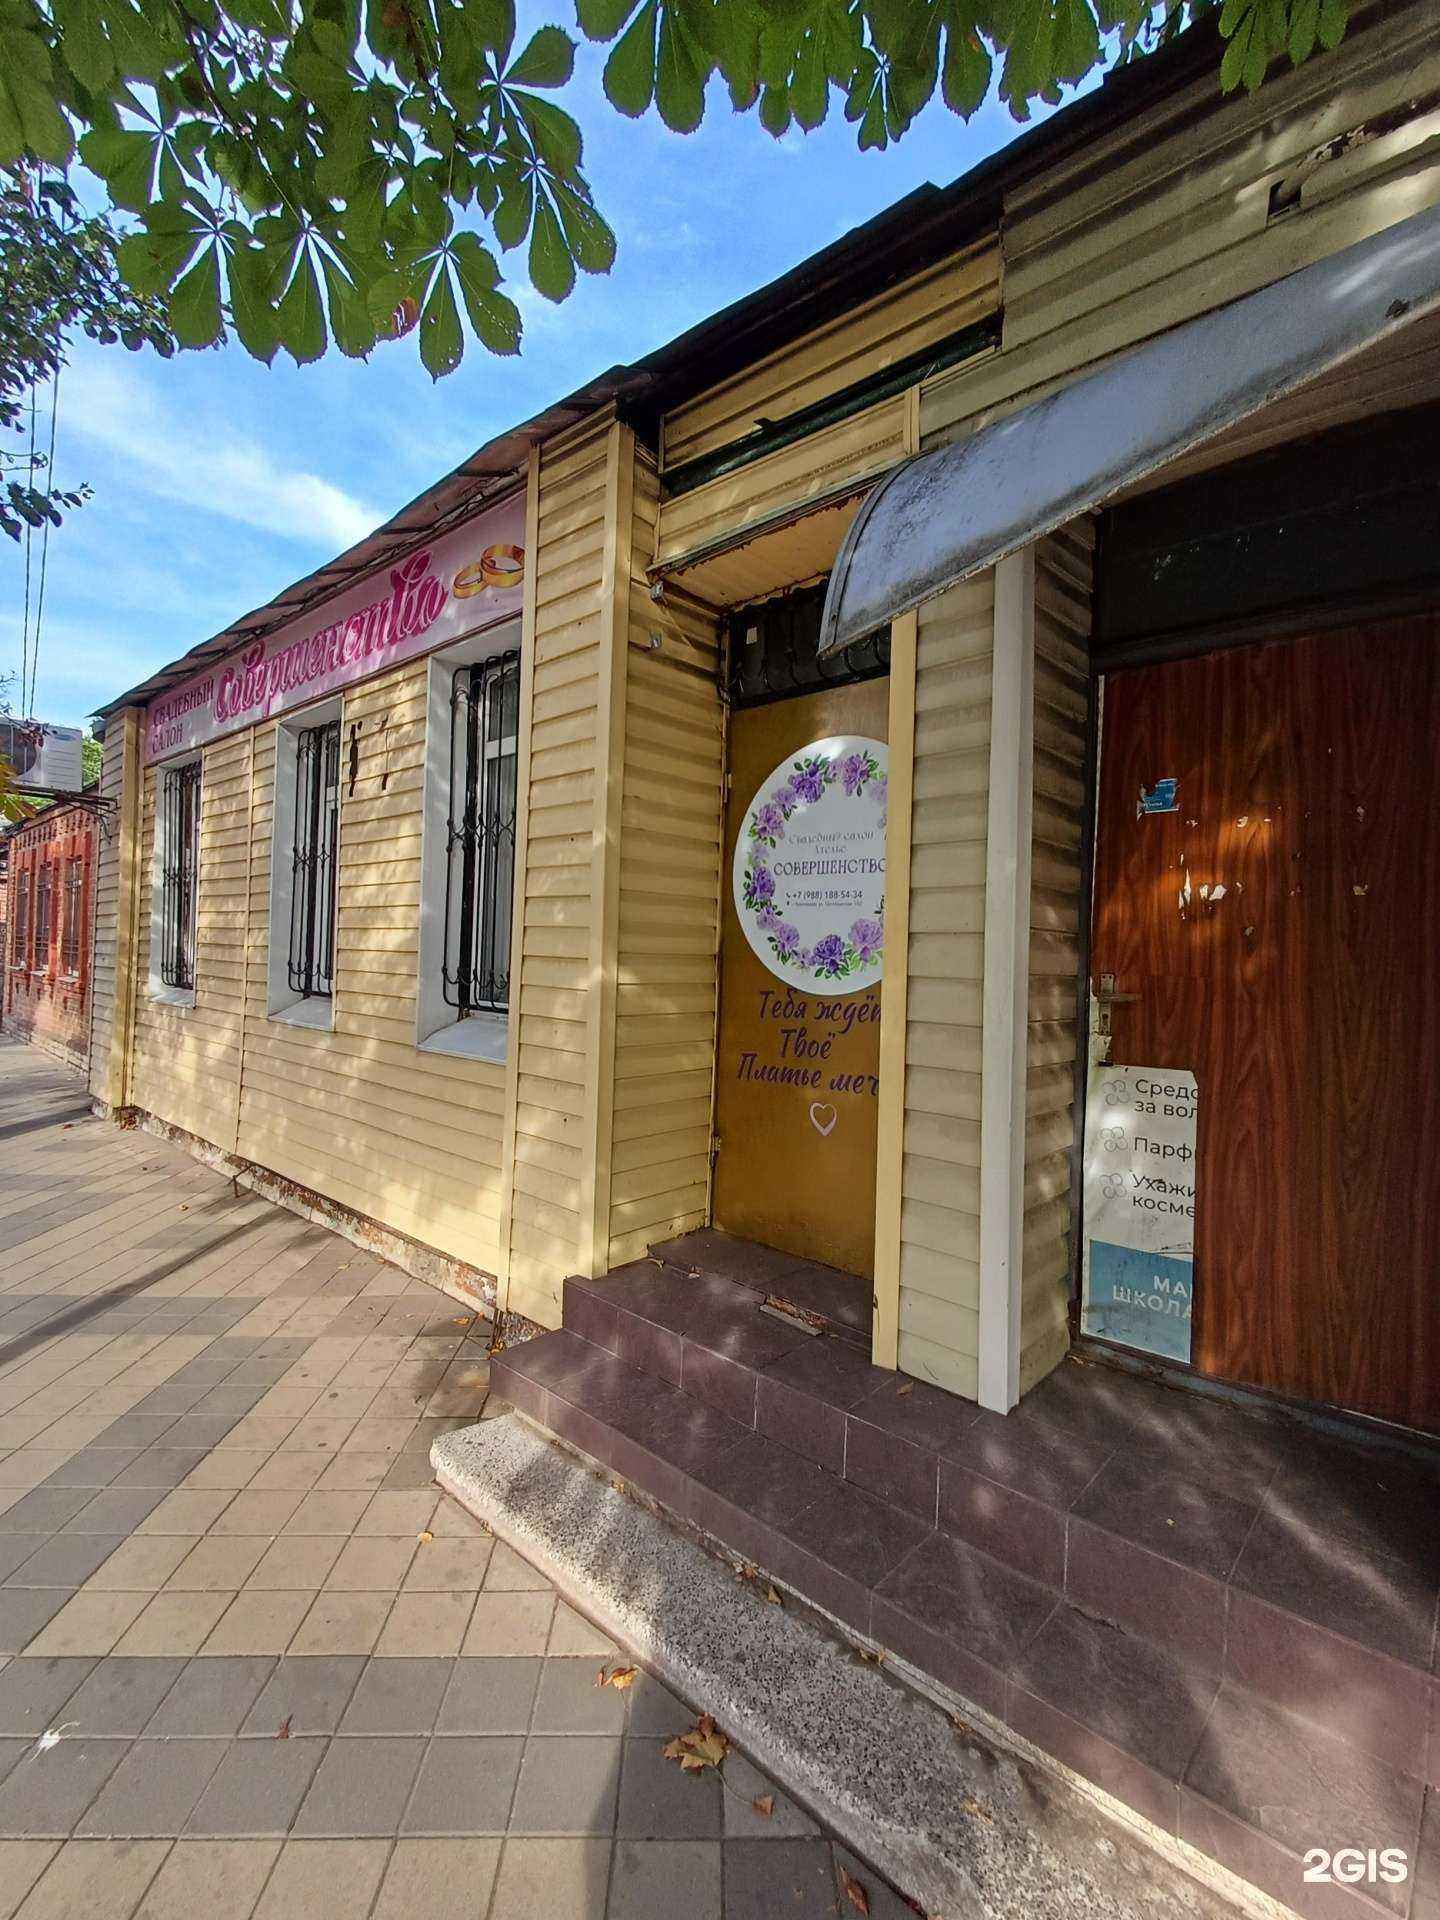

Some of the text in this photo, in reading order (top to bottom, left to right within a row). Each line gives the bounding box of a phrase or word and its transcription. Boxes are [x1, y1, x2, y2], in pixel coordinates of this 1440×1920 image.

[152, 724, 184, 754] САЛОН
[758, 988, 807, 1020] Тебя
[779, 1026, 836, 1060] Твоё
[736, 1052, 822, 1089] Платье
[1133, 1100, 1156, 1114] за
[1133, 1136, 1193, 1163] Парф
[1153, 1274, 1192, 1299] МА
